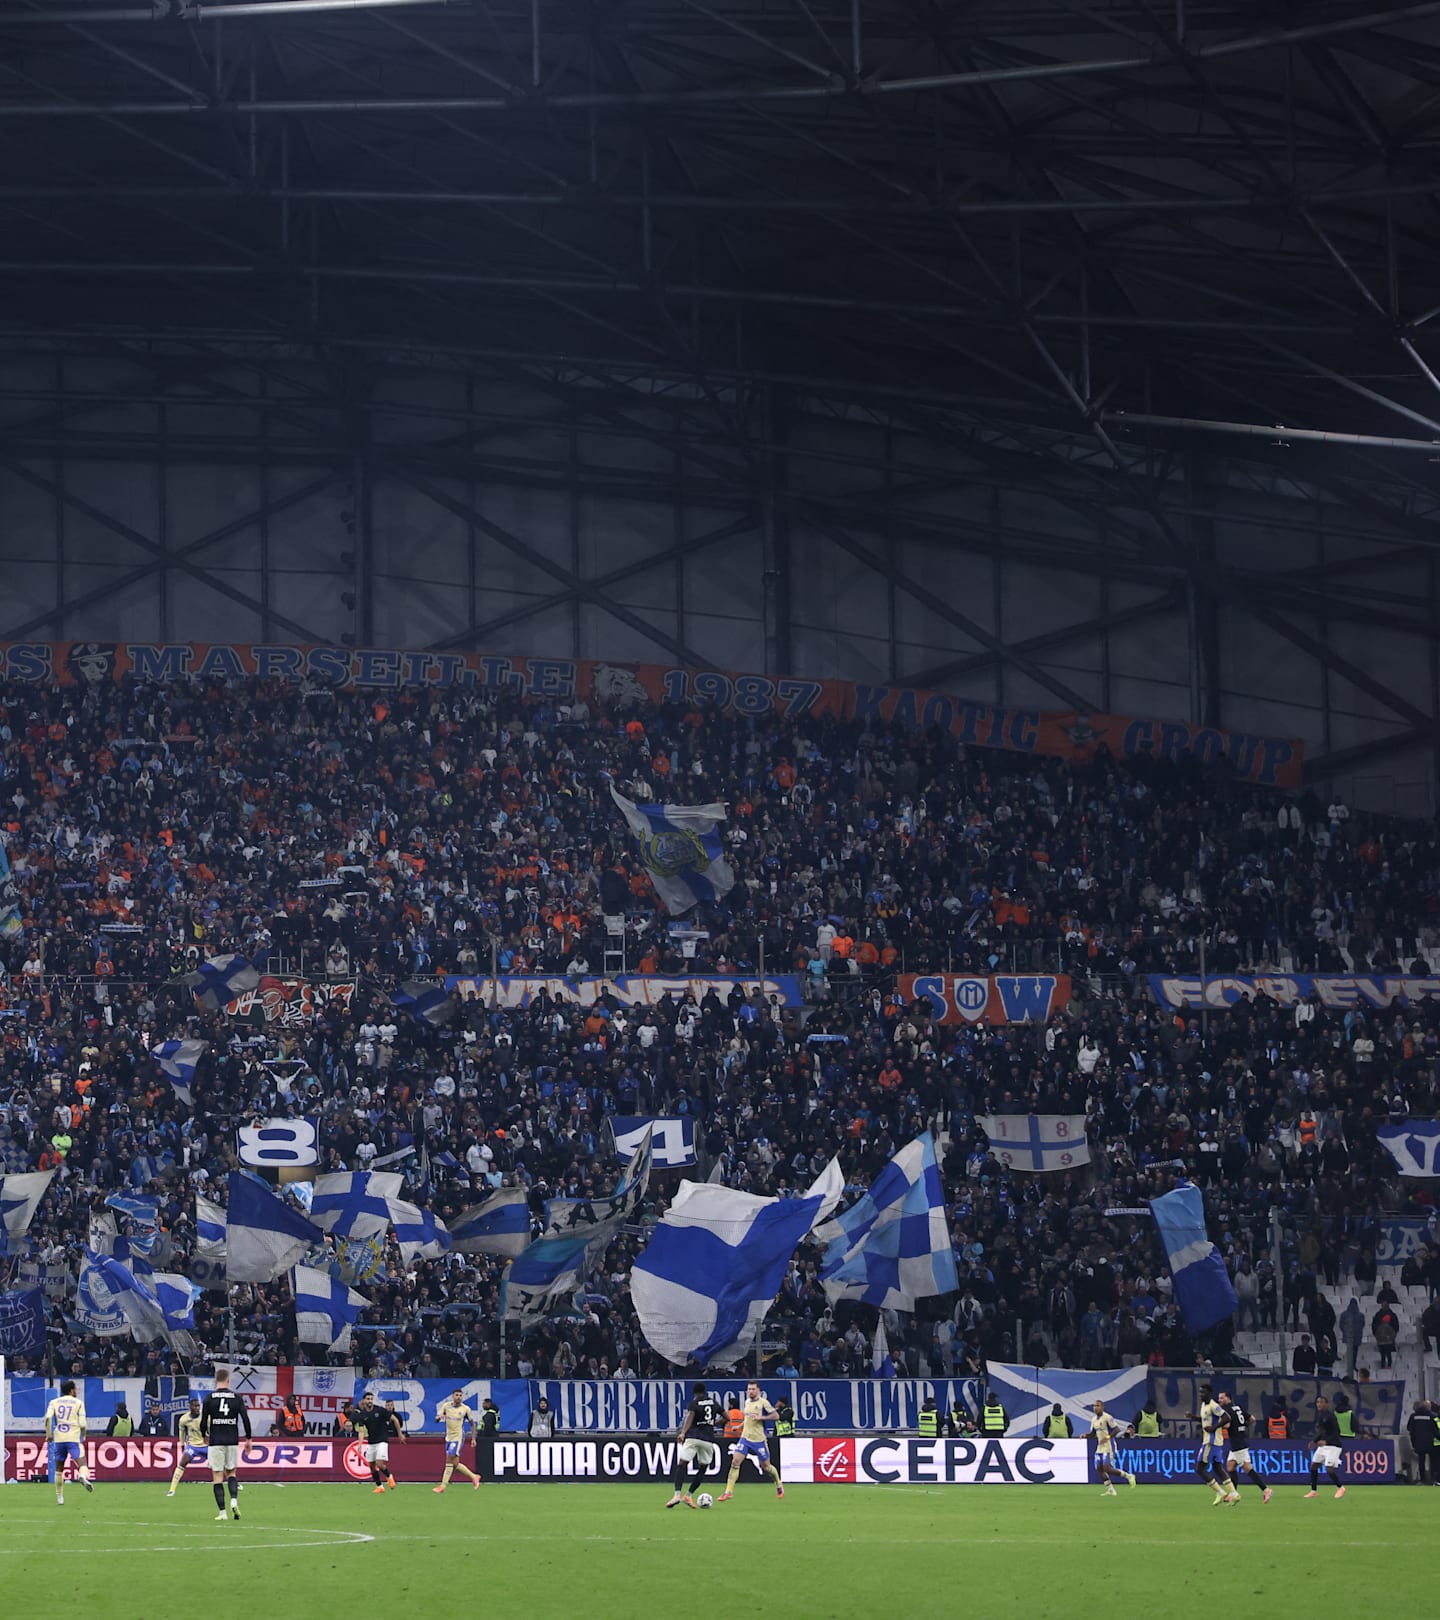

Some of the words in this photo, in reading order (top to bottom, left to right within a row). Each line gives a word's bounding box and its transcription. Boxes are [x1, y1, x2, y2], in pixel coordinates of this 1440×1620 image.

[127, 645, 577, 697] MARSEILLE
[662, 669, 823, 716] 1987
[856, 685, 1040, 750] KAOTIC
[1123, 721, 1294, 785] GROUP
[238, 1118, 318, 1166] 8
[615, 1119, 694, 1165] 4
[1056, 1121, 1069, 1137] 8
[86, 1318, 122, 1329] ULTRAS
[57, 1404, 73, 1421] 97
[219, 1397, 230, 1416] 4
[241, 1393, 350, 1413] ARSILLE
[704, 1405, 713, 1420] 3
[848, 1379, 980, 1429] ULTRAS
[1236, 1410, 1246, 1425] 6
[493, 1441, 597, 1476] PUMA
[861, 1439, 1056, 1483] CEPAC
[1093, 1448, 1196, 1479] YMPIQUE
[1343, 1450, 1389, 1475] 1899
